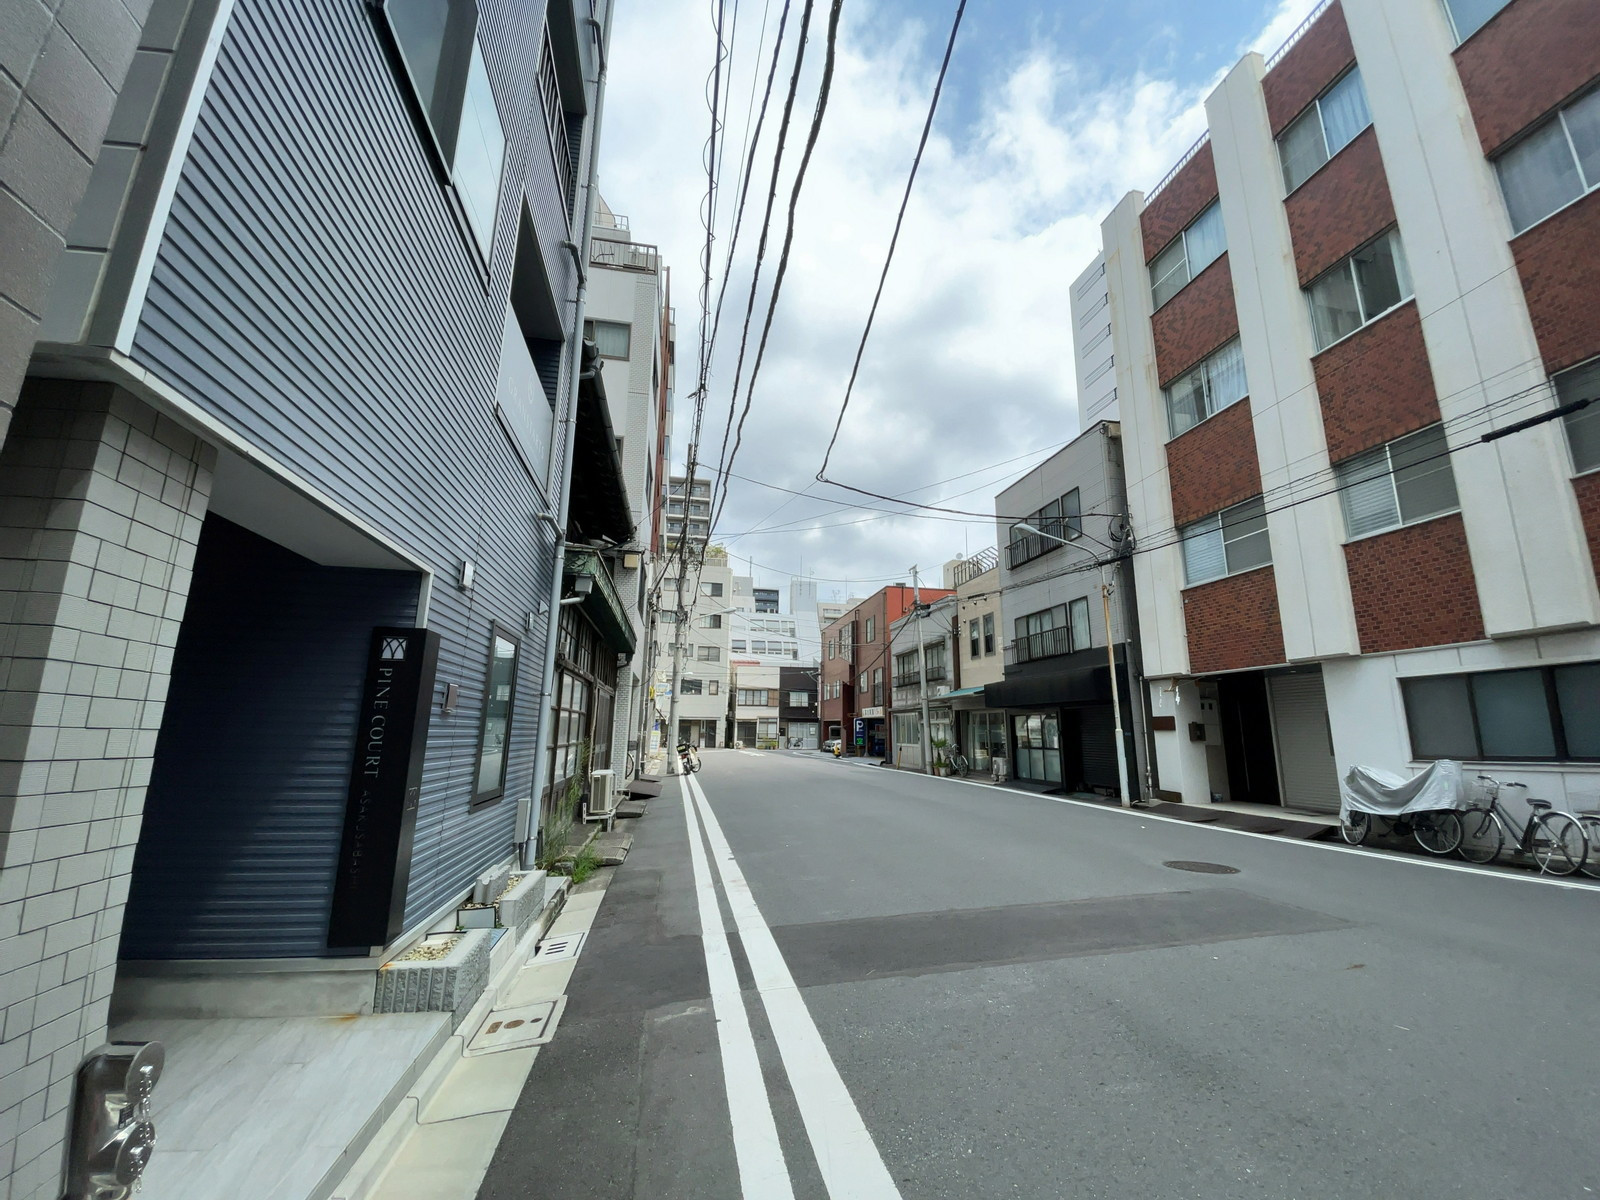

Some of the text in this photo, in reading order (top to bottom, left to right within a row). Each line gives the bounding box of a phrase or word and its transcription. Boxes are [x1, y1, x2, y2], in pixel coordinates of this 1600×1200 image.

[373, 667, 393, 710] PINE
[364, 715, 386, 779] COURT
[856, 720, 864, 732] P
